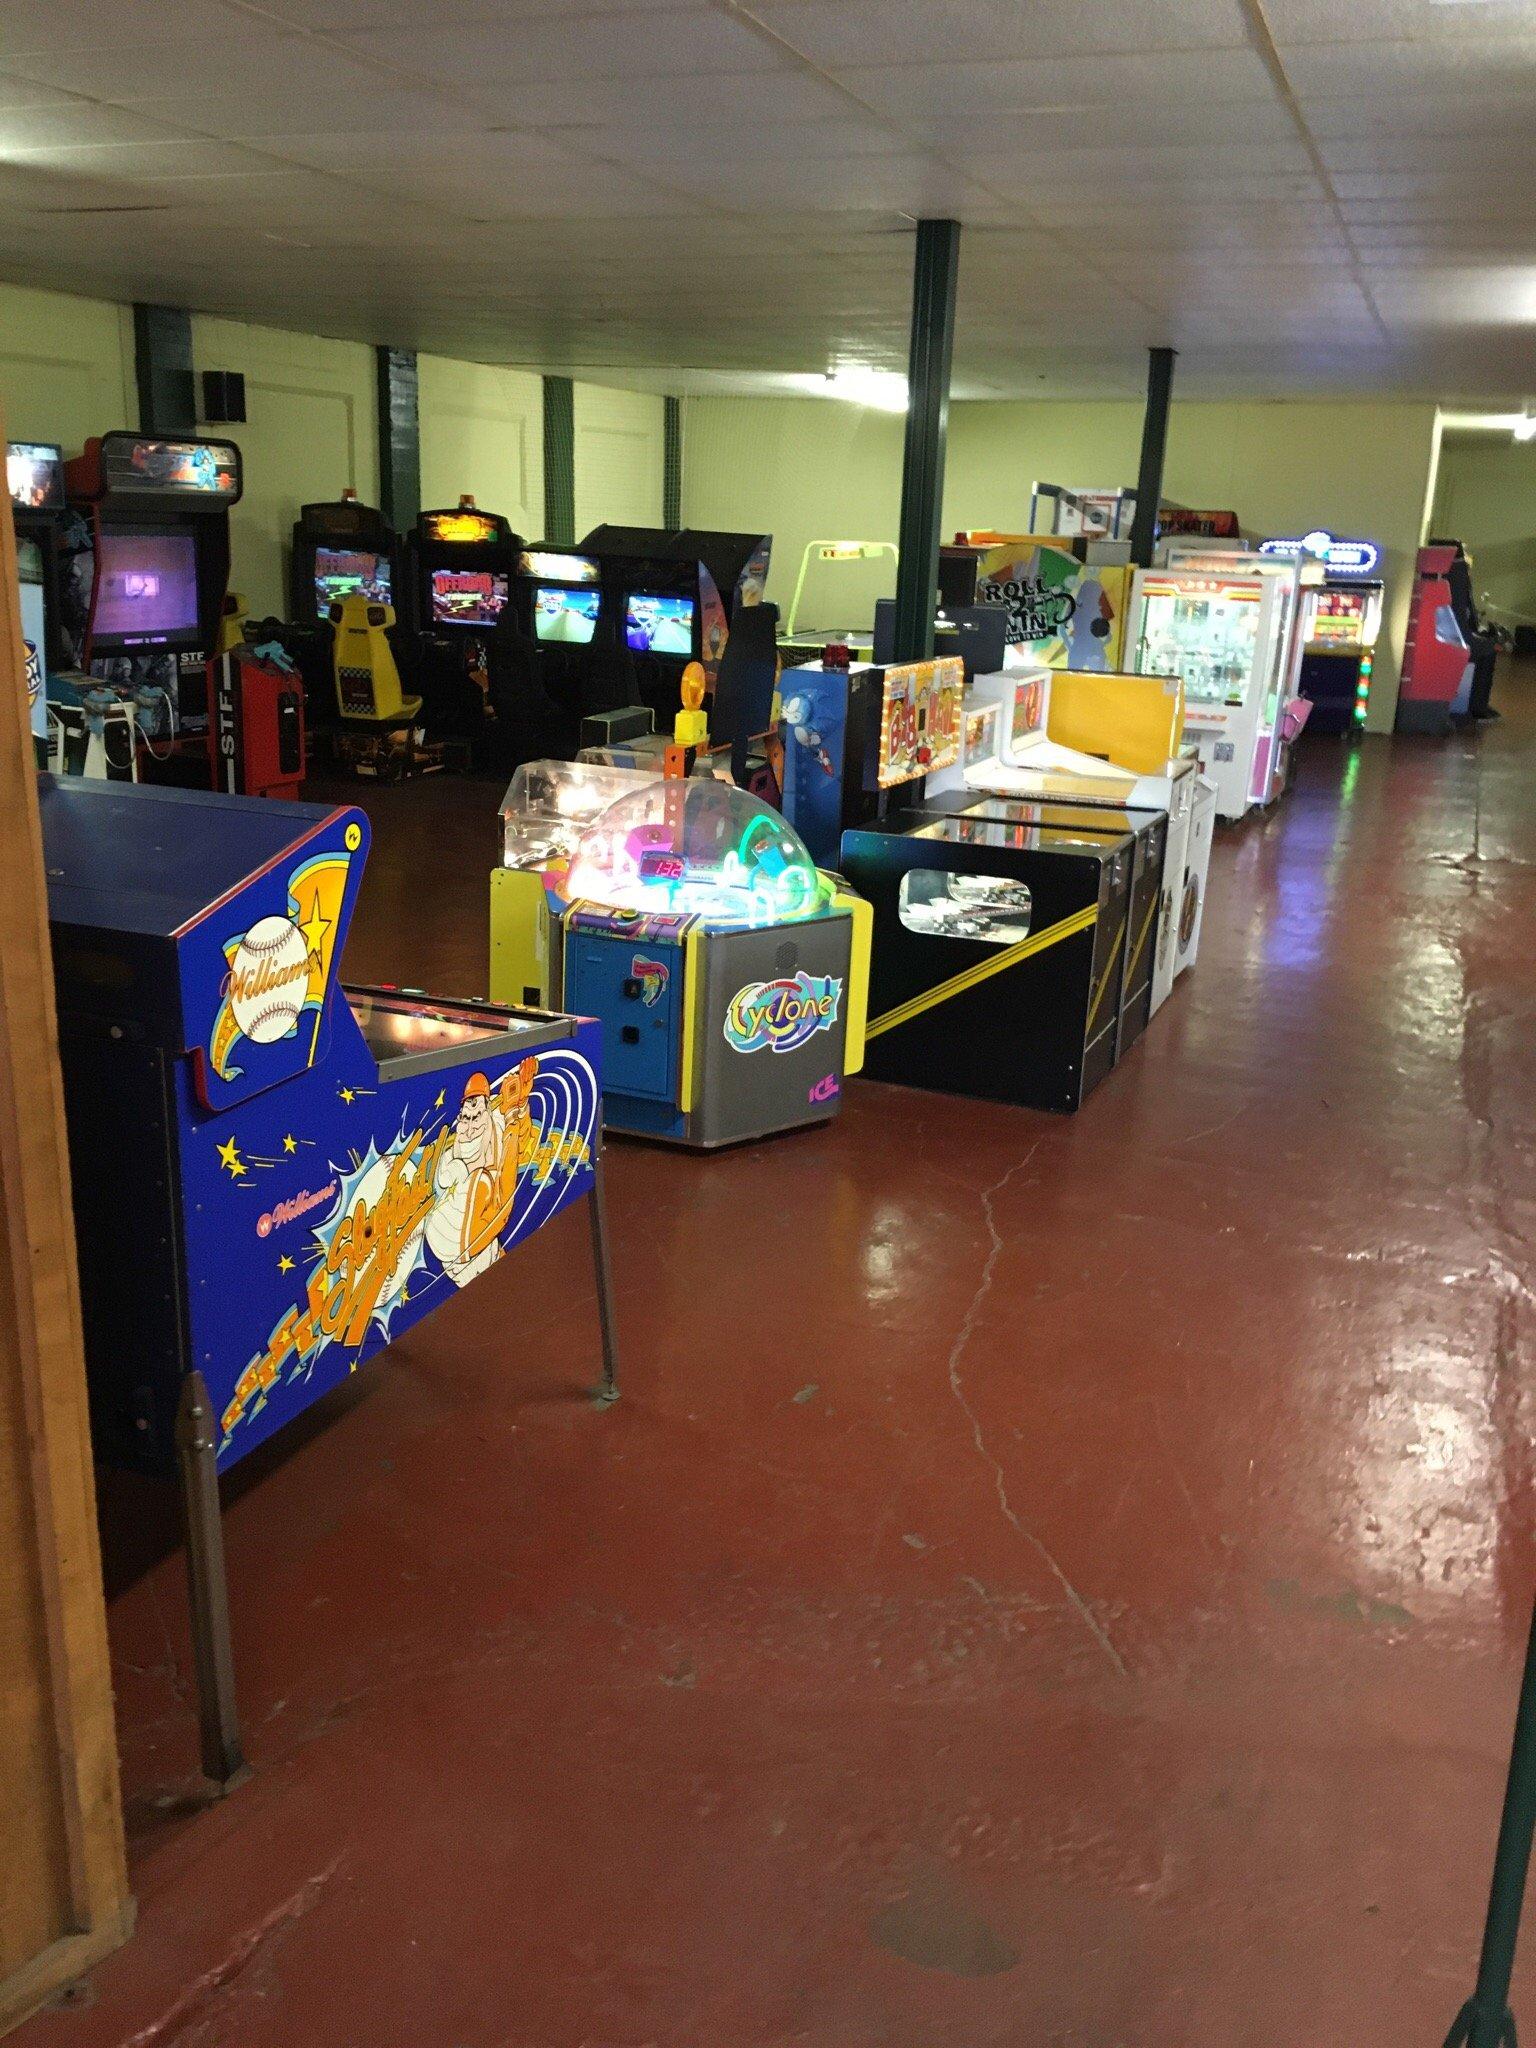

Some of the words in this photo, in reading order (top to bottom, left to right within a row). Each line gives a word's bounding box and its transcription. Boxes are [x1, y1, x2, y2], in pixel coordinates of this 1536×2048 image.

[985, 577, 1050, 601] ROLL
[180, 652, 205, 662] STF
[220, 692, 235, 756] STF
[220, 955, 317, 1004] Williams
[730, 985, 833, 1039] Cyclone
[808, 1074, 839, 1103] ICE
[272, 1179, 337, 1229] Williams
